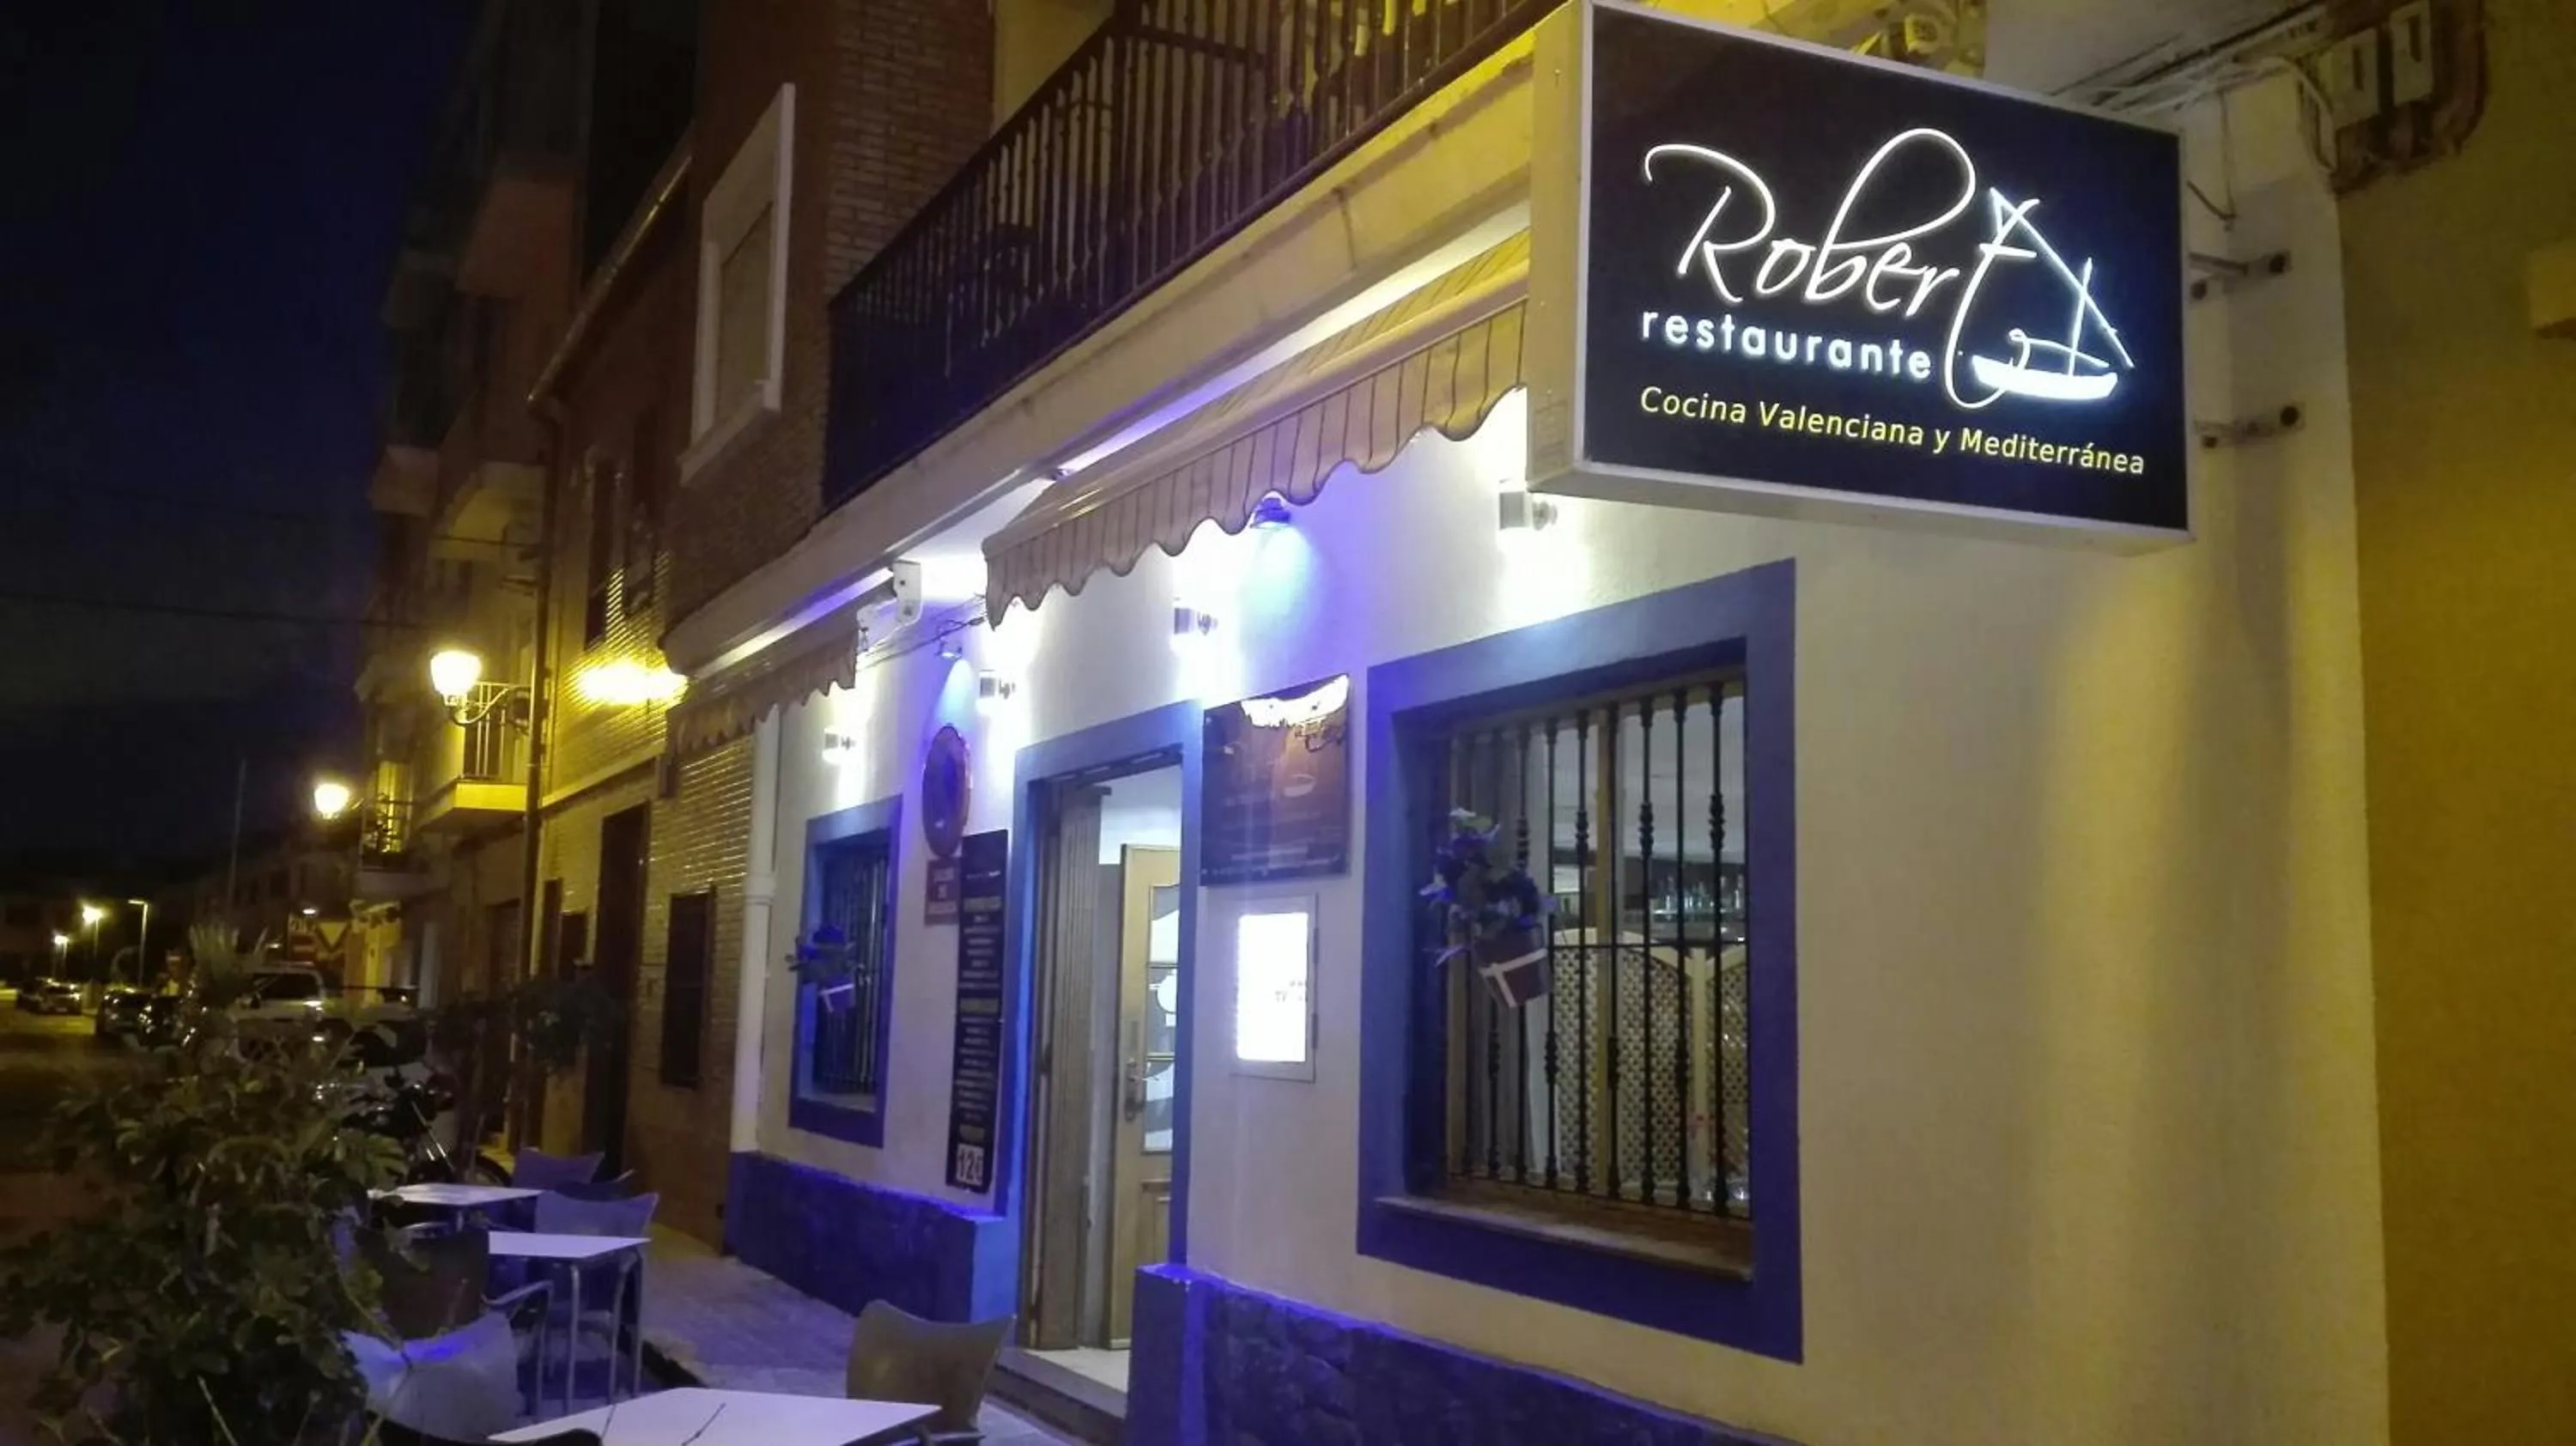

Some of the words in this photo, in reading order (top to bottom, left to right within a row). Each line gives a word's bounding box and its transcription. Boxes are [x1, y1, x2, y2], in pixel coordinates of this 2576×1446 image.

[1643, 127, 2040, 410] Robert
[1642, 310, 1932, 382] restaurante
[1641, 386, 1747, 424] Cocina
[1759, 400, 1924, 446] Valenciana
[1933, 428, 1953, 454] y
[1959, 427, 2145, 474] Mediterránea
